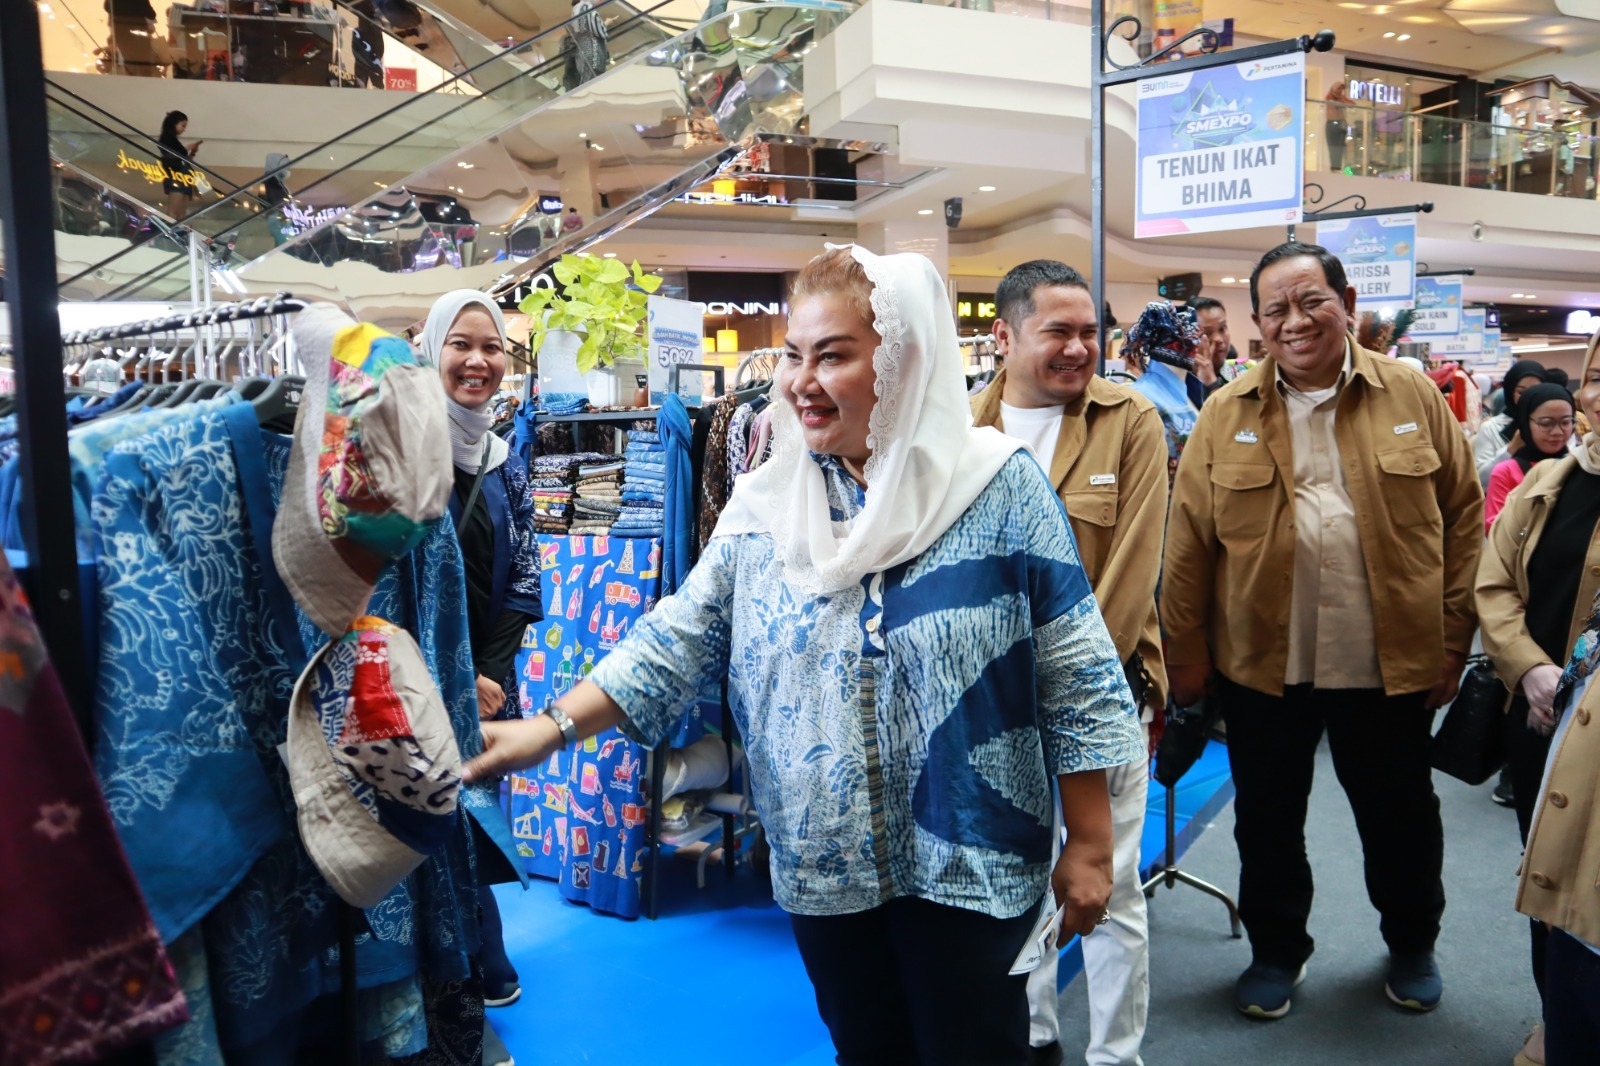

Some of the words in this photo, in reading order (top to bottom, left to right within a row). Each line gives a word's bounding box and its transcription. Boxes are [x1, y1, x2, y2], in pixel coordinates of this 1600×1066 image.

[1186, 113, 1252, 134] SMEXPO
[1157, 151, 1225, 179] TENUN
[1233, 144, 1280, 170] IKAT
[1182, 178, 1252, 206] BHIMA
[1346, 264, 1391, 279] ARISSA
[658, 345, 696, 369] 50%
